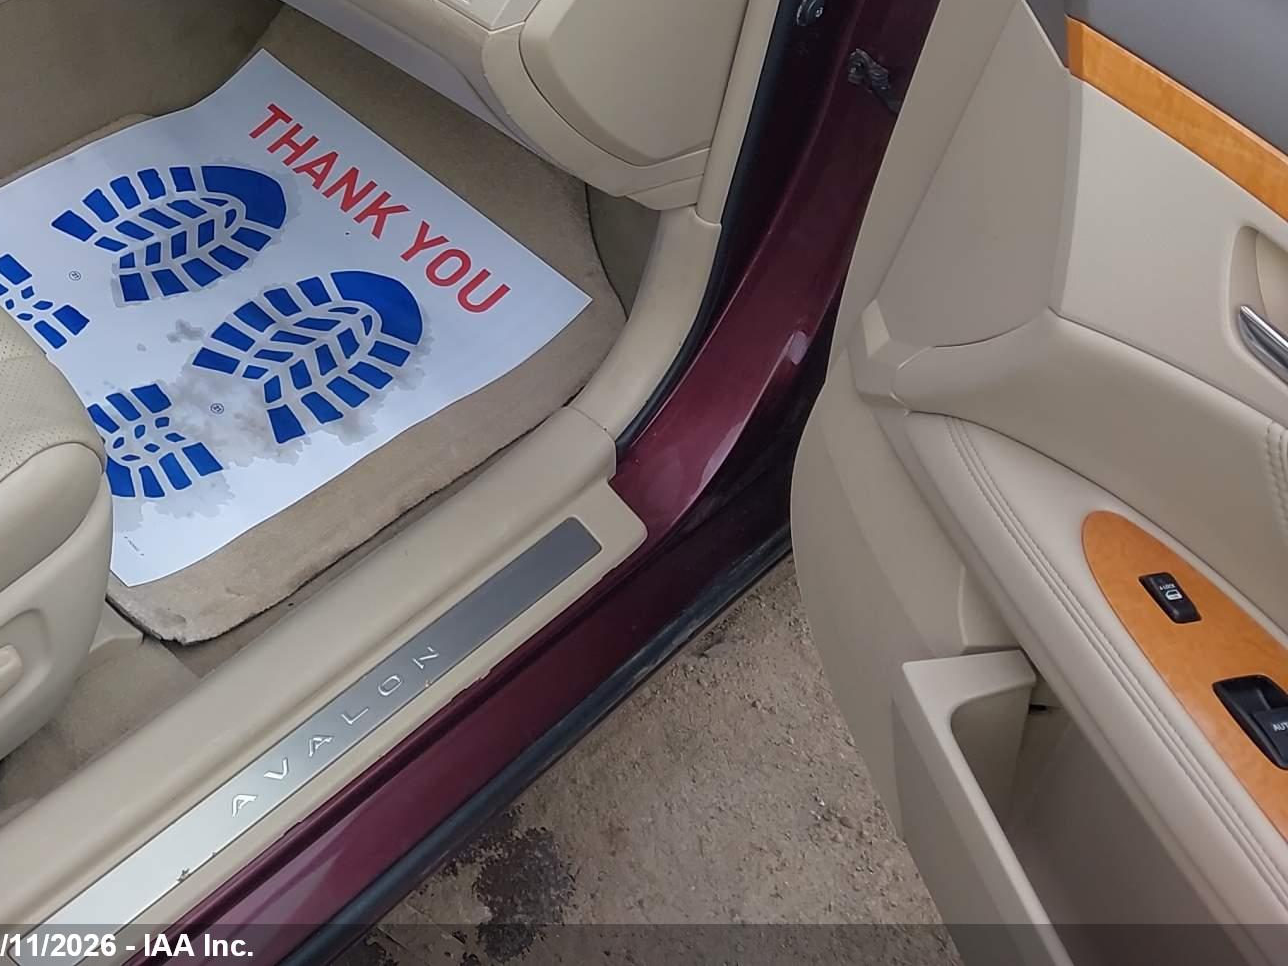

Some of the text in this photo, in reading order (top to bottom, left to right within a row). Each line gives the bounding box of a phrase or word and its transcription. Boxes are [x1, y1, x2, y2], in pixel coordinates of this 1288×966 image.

[249, 103, 511, 313] THANK YOU
[232, 646, 440, 817] AVALON
